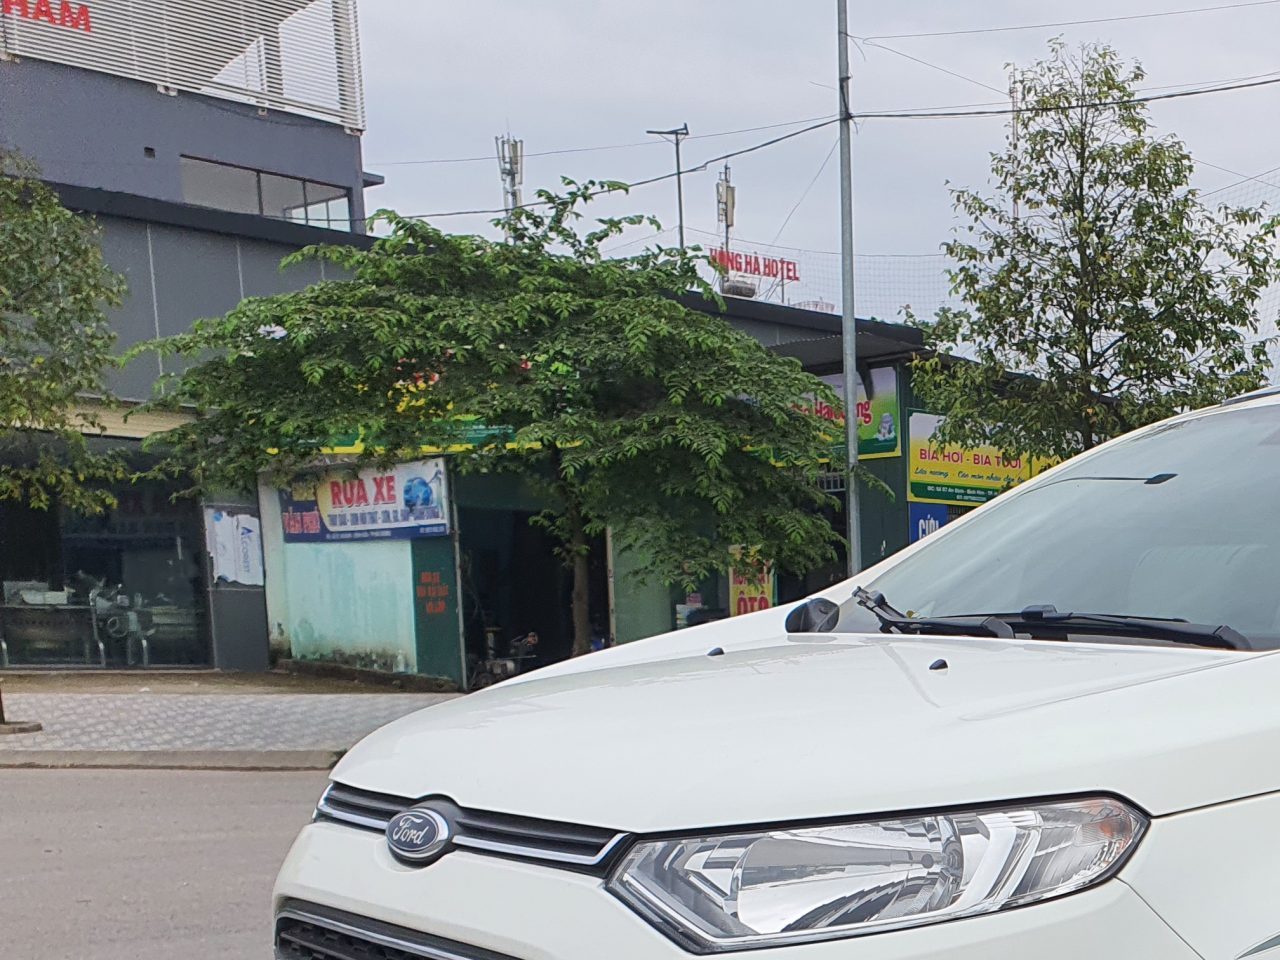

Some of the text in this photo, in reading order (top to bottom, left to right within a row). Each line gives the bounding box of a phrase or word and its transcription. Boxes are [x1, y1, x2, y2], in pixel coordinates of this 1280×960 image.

[763, 257, 800, 281] HOTEL
[919, 448, 939, 461] BIA
[973, 453, 992, 466] BIA
[373, 475, 397, 504] XE
[393, 815, 430, 845] Ford
